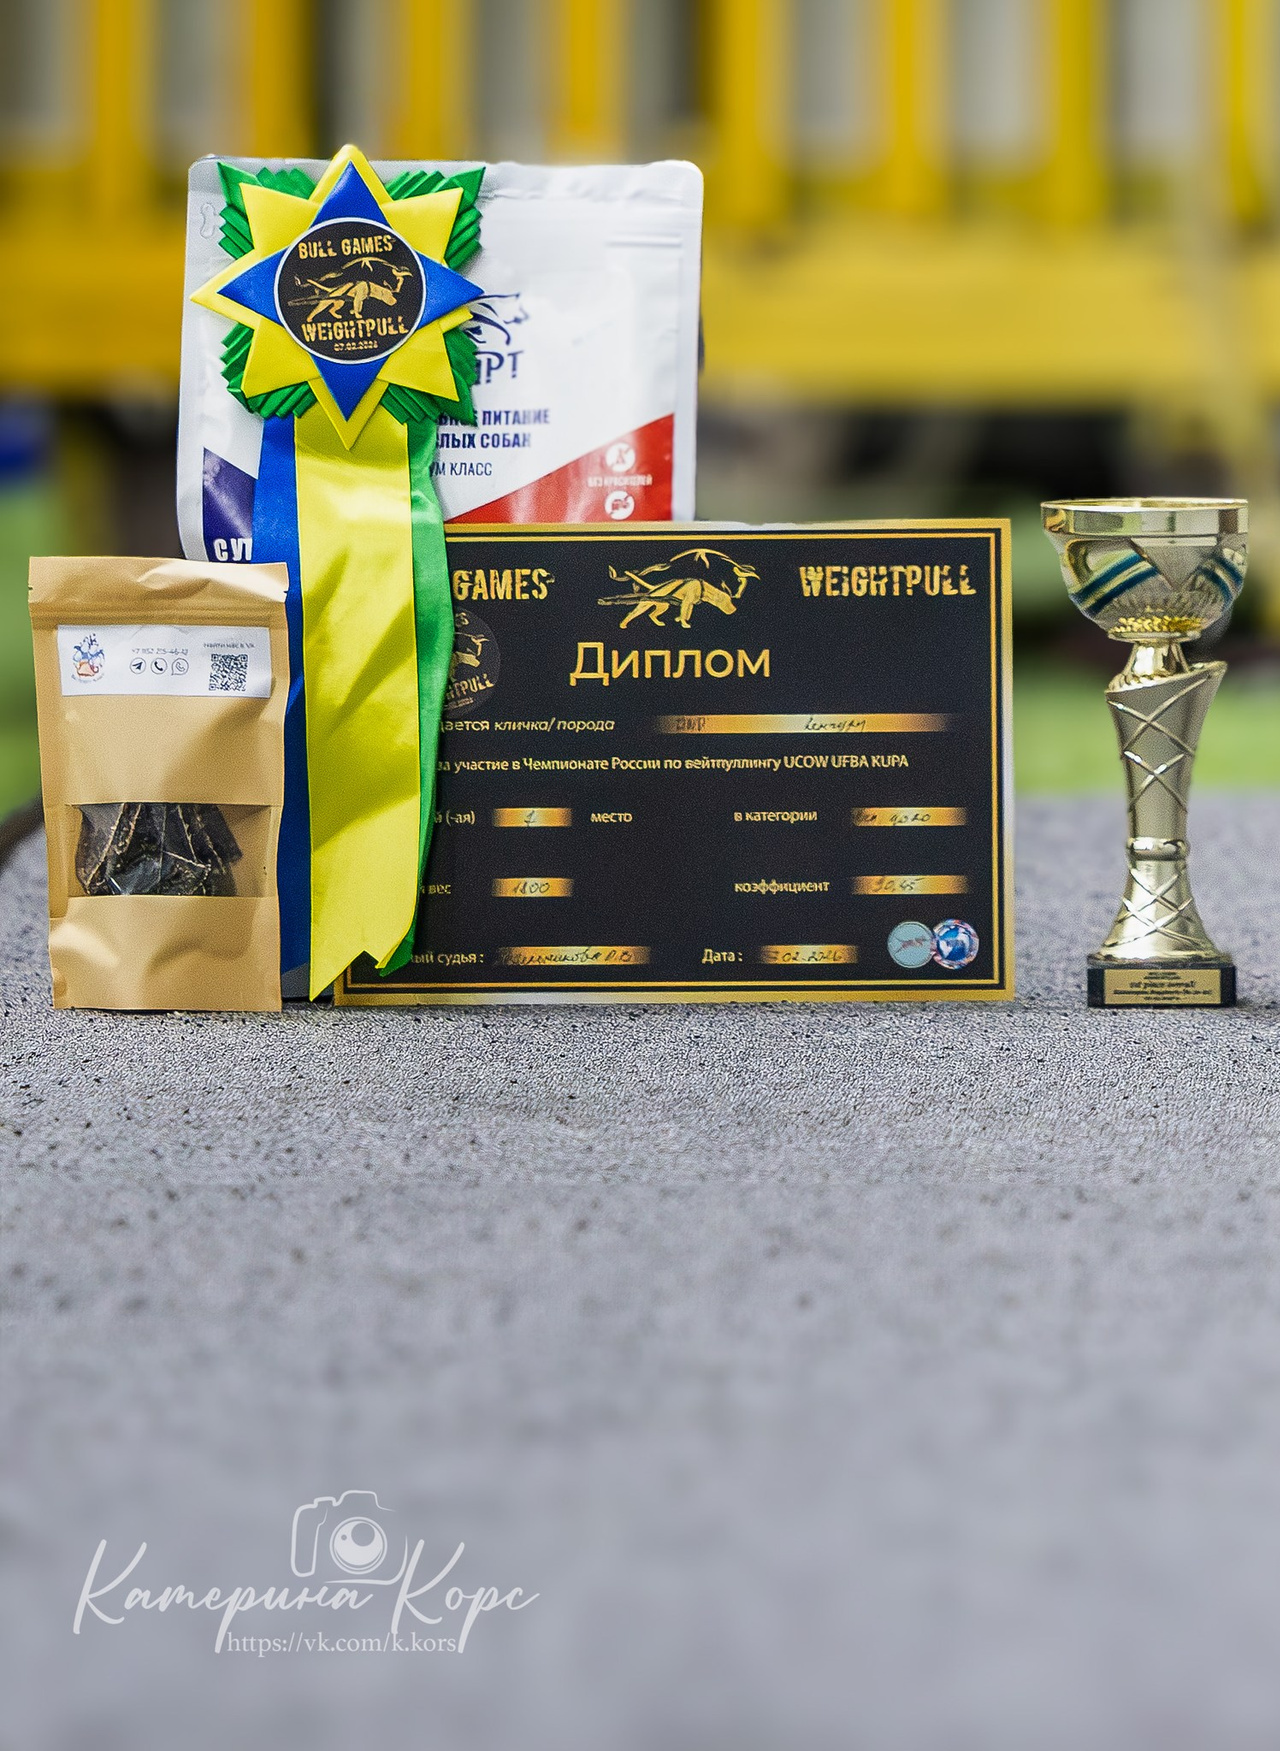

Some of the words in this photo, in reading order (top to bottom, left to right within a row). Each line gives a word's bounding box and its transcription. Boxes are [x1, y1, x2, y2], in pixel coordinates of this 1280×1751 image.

[298, 238, 338, 260] BULL
[340, 234, 394, 256] GAMES
[301, 314, 409, 343] WEIGHTPULL
[481, 408, 551, 427] ПИТАНИЕ
[480, 432, 532, 449] СОБАК
[449, 461, 493, 477] КЛАСС
[453, 568, 551, 601] GAMES
[799, 564, 977, 597] WEIGHTPULL
[568, 641, 771, 687] Диплом
[454, 760, 509, 774] участие
[511, 760, 521, 771] в
[523, 757, 609, 771] Чемпионате
[611, 756, 661, 770] России
[663, 759, 682, 770] по
[784, 755, 830, 769] UCOW
[831, 754, 869, 768] UFBA
[871, 754, 909, 768] KUPA
[590, 811, 633, 824] место
[733, 811, 743, 823] в
[745, 811, 818, 824] категории
[733, 878, 831, 894] коэффициент
